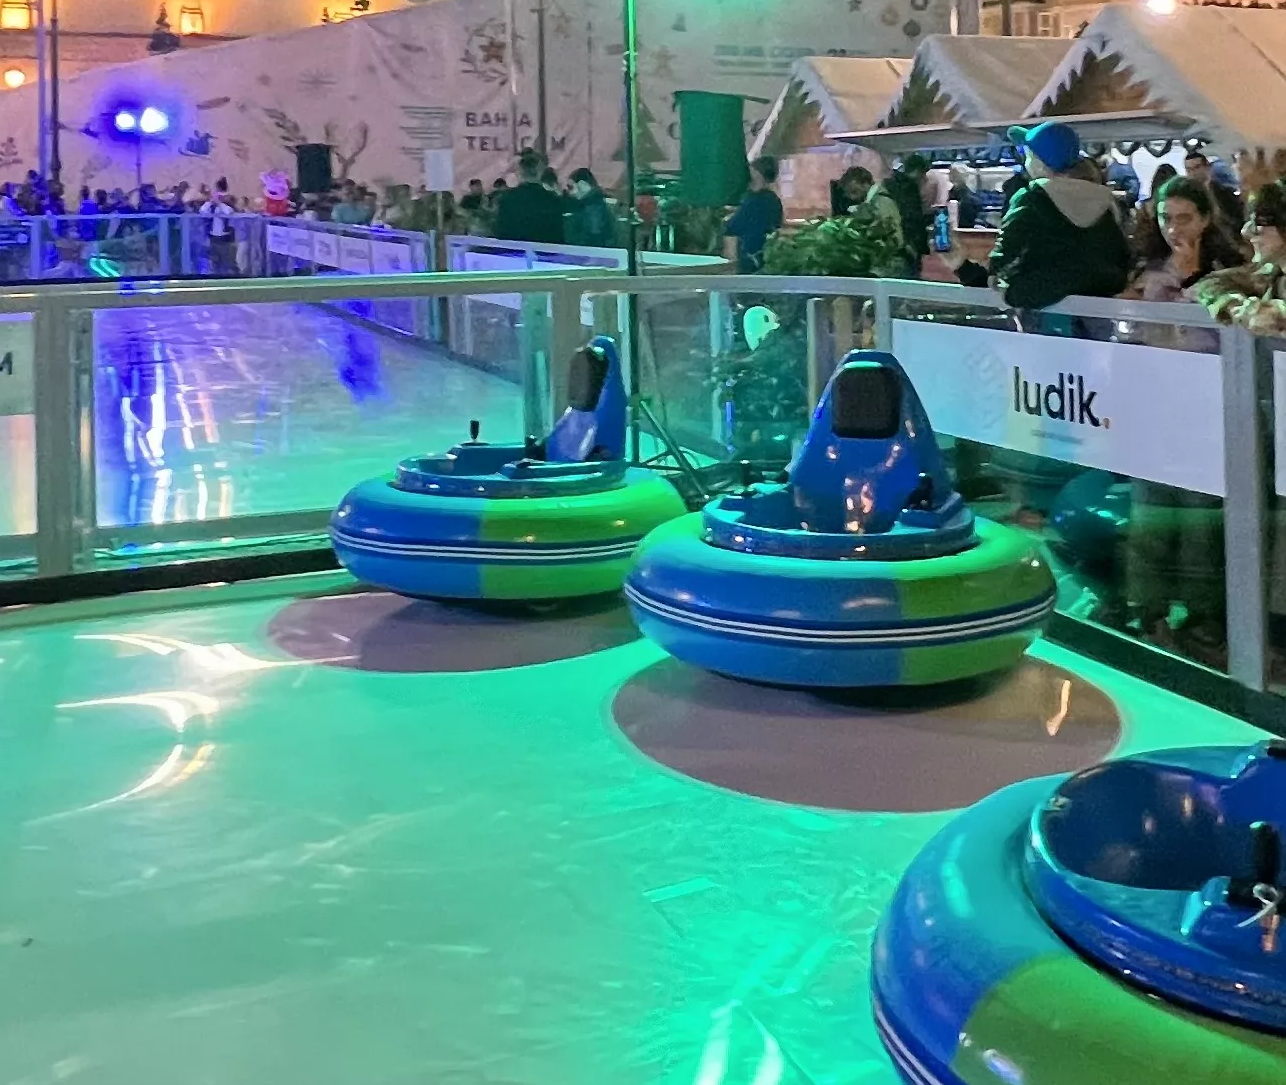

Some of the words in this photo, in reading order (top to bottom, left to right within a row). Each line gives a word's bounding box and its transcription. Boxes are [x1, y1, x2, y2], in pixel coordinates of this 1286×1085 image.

[465, 111, 532, 128] BAHA
[464, 135, 566, 152] TELCM
[1013, 365, 1111, 430] ludik.
